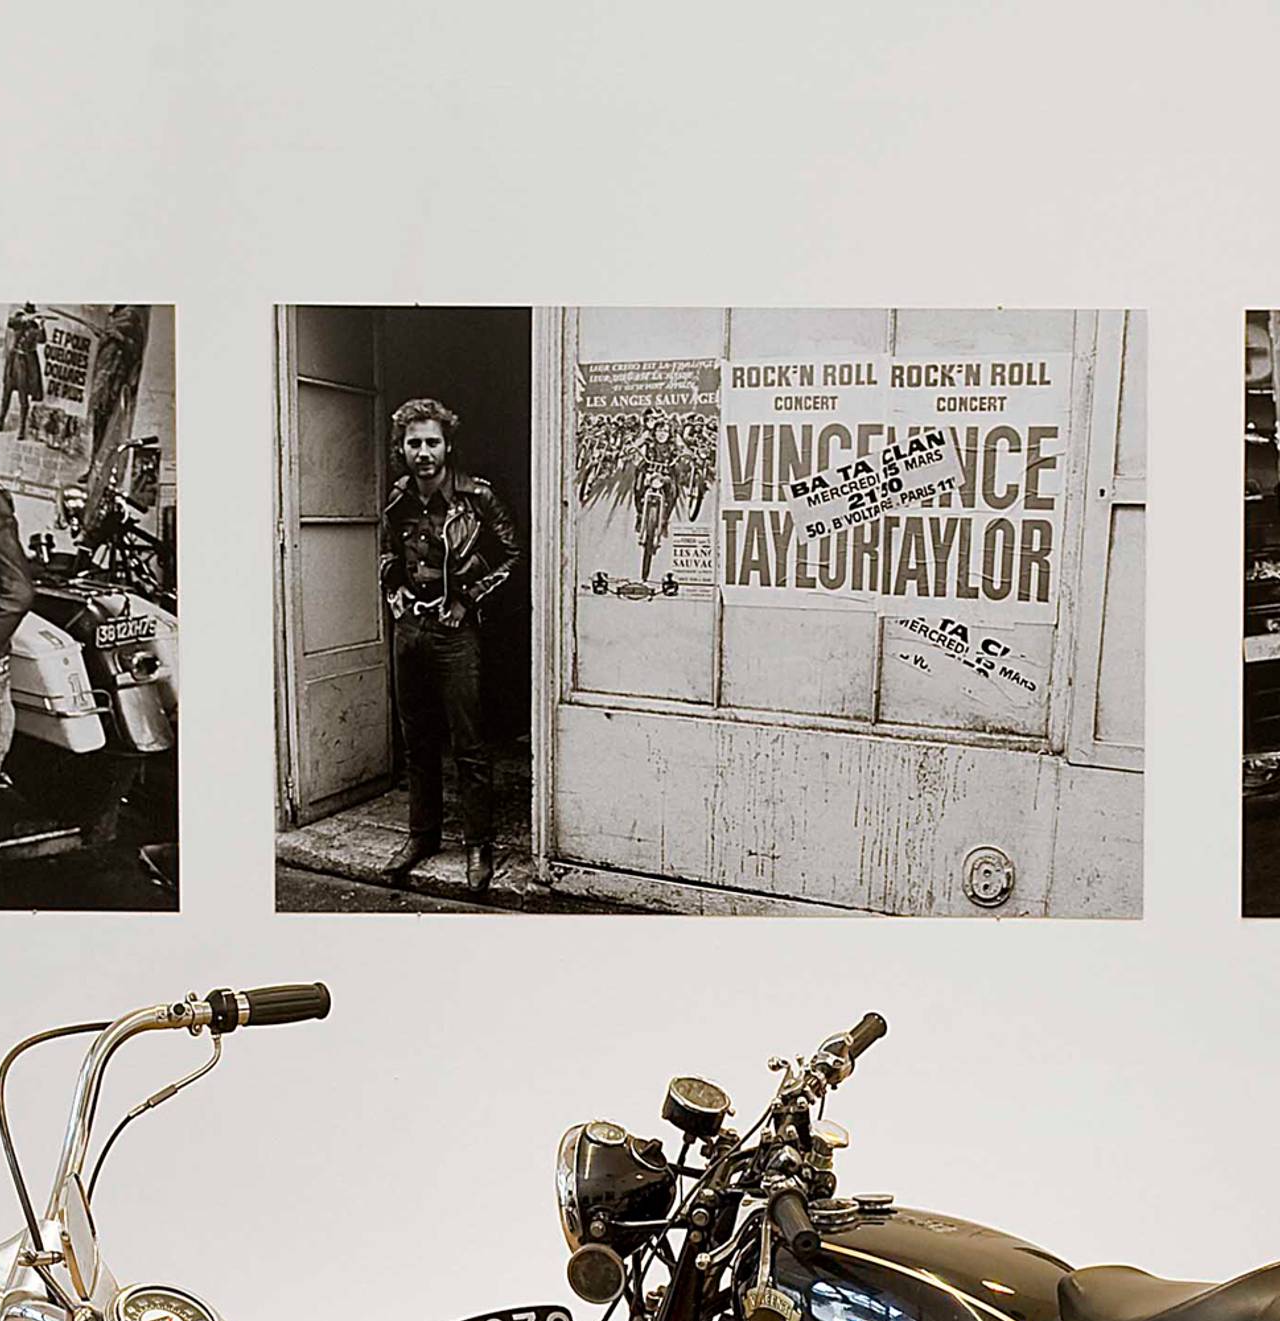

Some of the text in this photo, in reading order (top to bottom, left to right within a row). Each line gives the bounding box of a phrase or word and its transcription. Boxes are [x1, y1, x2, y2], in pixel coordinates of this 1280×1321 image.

[823, 362, 878, 387] ROLL
[990, 362, 1052, 386] ROLL
[586, 395, 608, 407] LES
[610, 394, 653, 407] ANGES
[774, 395, 839, 412] CONCERT
[936, 396, 1008, 413] CONCERT
[790, 430, 946, 498] BA TA CLAN
[807, 473, 881, 507] MERCREDI
[904, 449, 944, 472] MARS
[900, 482, 937, 506] PARIS
[882, 515, 1055, 603] TAYLOR
